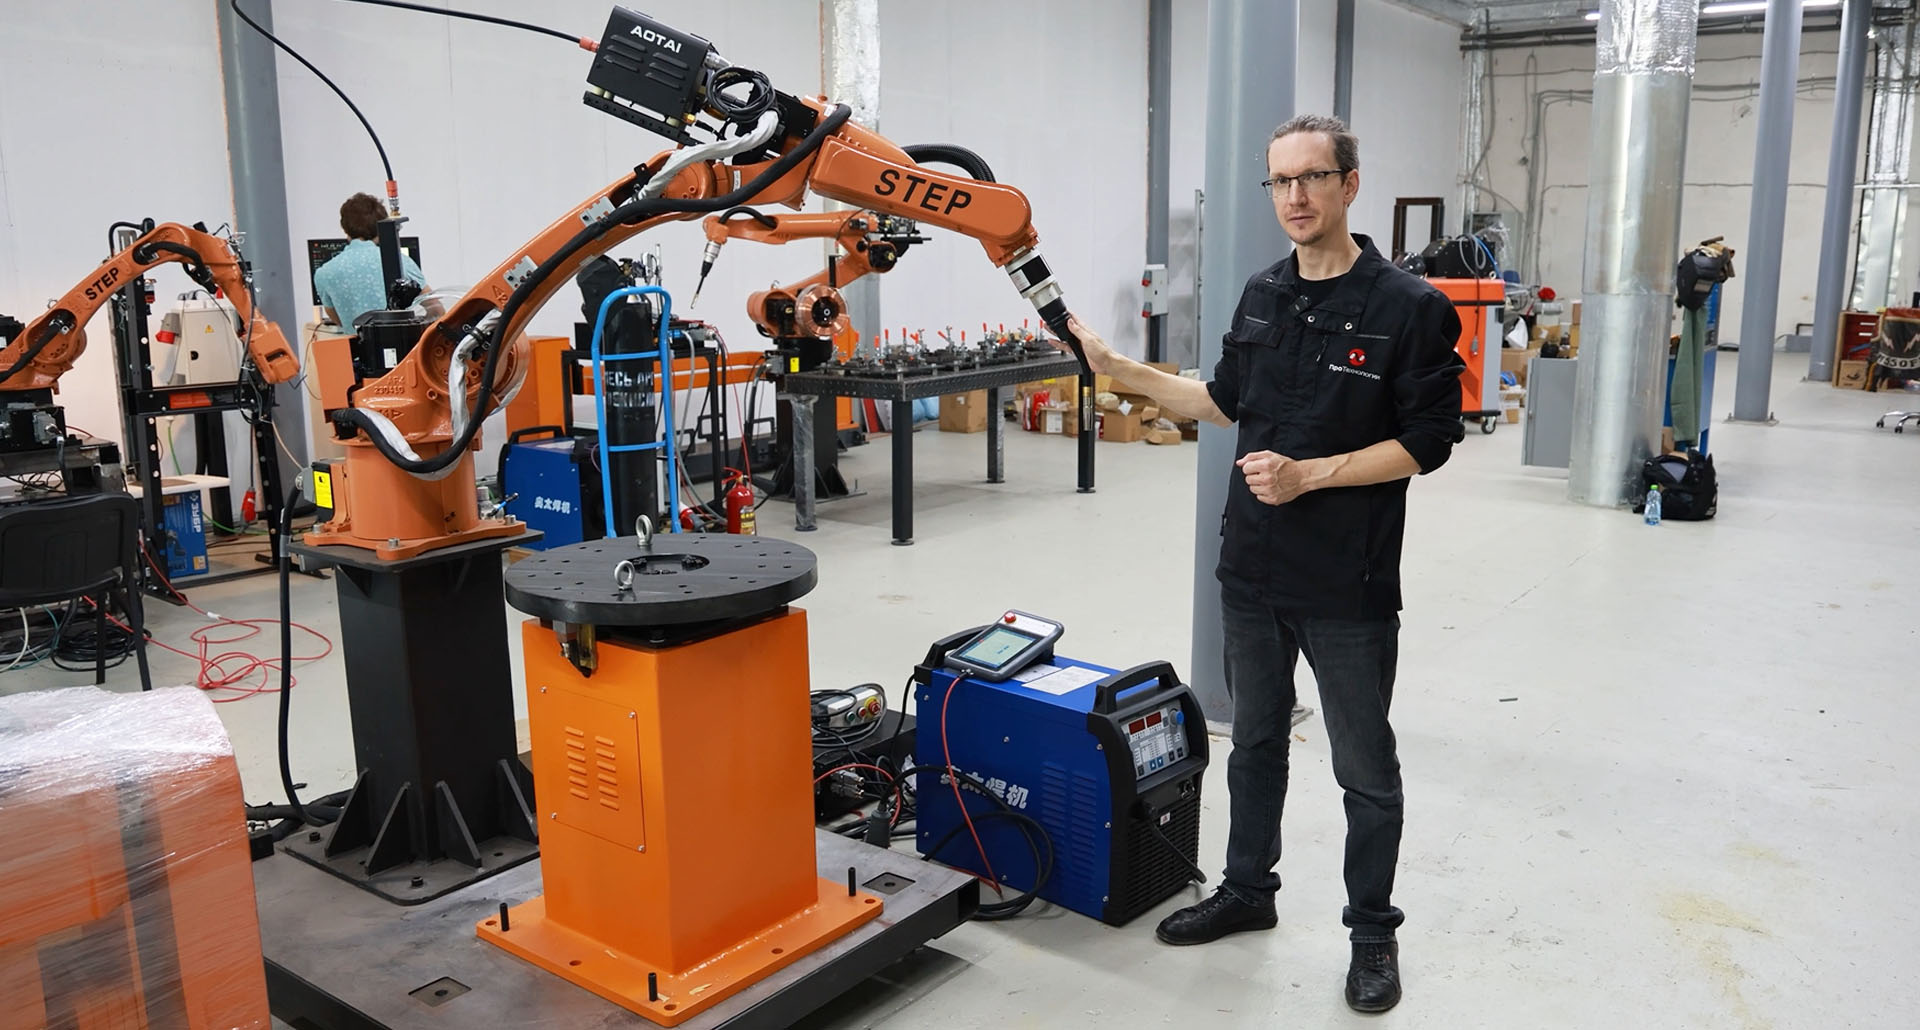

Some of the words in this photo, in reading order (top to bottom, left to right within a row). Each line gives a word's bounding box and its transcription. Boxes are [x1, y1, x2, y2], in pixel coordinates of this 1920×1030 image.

[630, 25, 683, 54] AOTAI
[874, 169, 972, 216] STEP
[85, 267, 119, 300] STEP
[605, 371, 632, 388] ЕСЬ
[190, 502, 202, 533] ЗУБР
